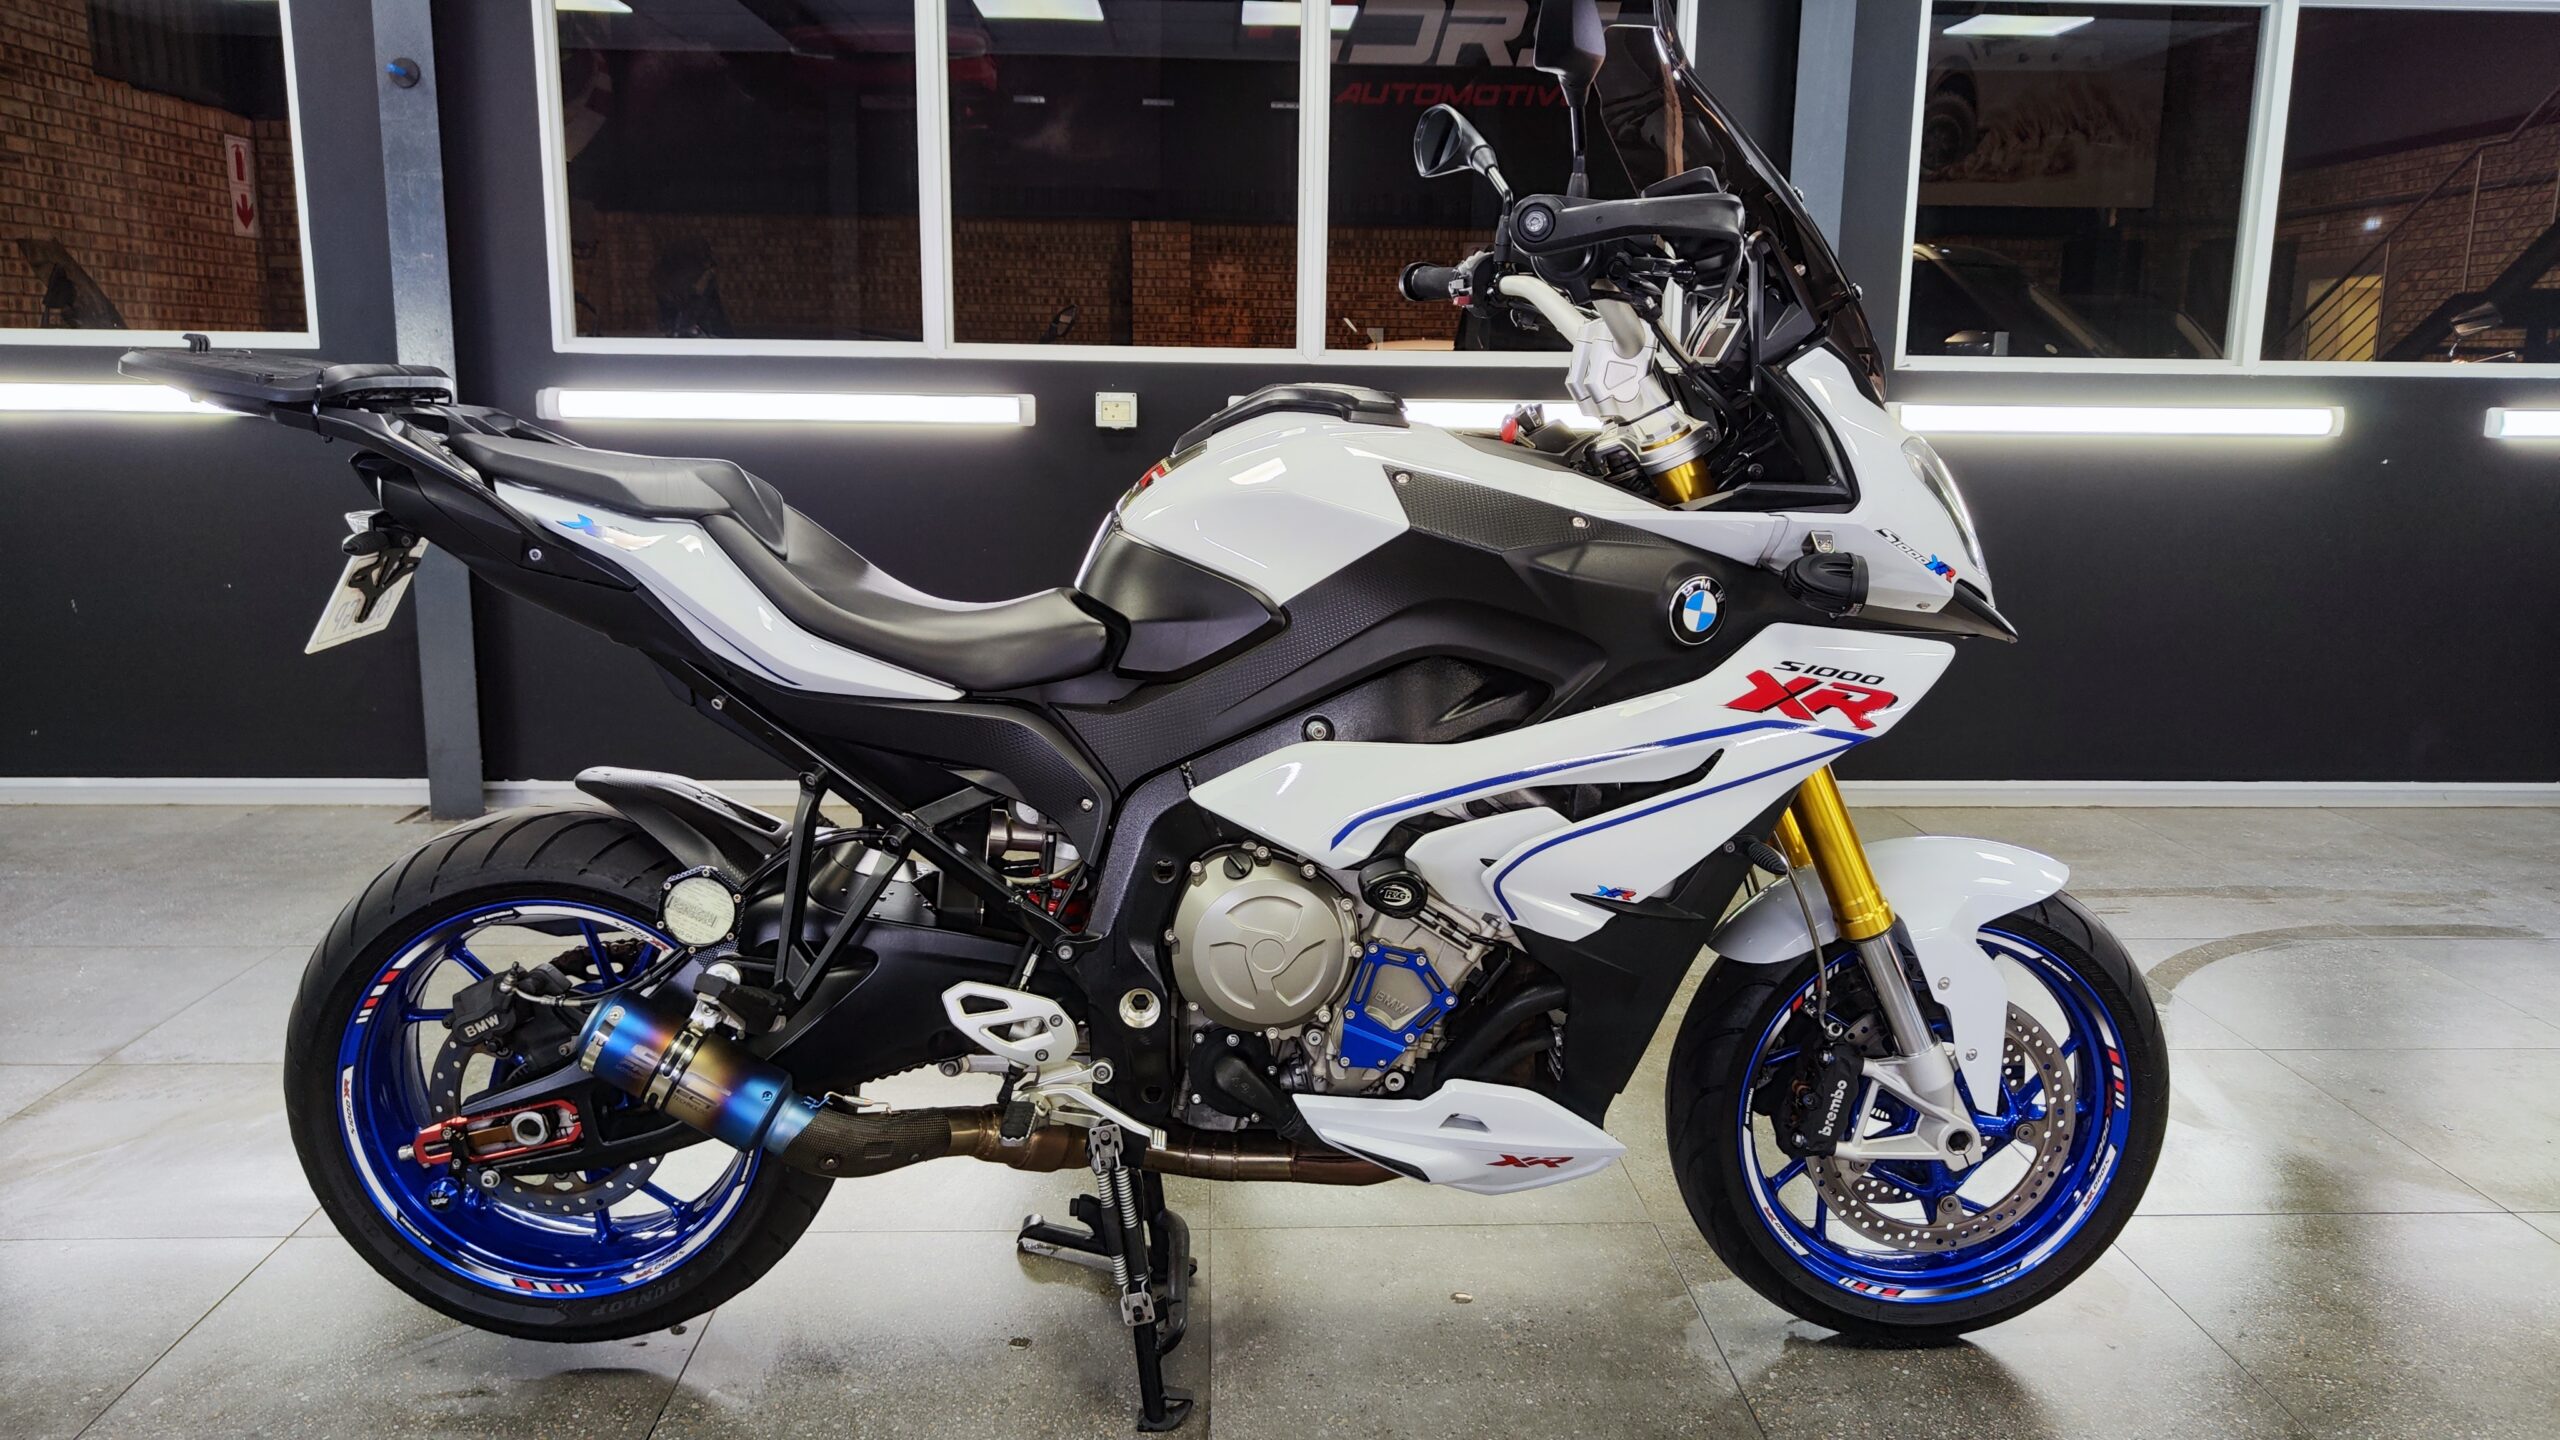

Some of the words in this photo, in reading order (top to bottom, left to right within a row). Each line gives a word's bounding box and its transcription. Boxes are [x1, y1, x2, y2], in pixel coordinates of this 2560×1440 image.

[1335, 82, 1568, 108] AUTOMOTIV
[1773, 660, 1885, 685] S1000
[1722, 669, 1898, 730] XR
[1375, 990, 1409, 1014] BMW
[464, 1014, 500, 1038] BMW
[1818, 1079, 1848, 1136] brembo
[1486, 1154, 1574, 1168] XR
[592, 1277, 681, 1316] DUNLOP
